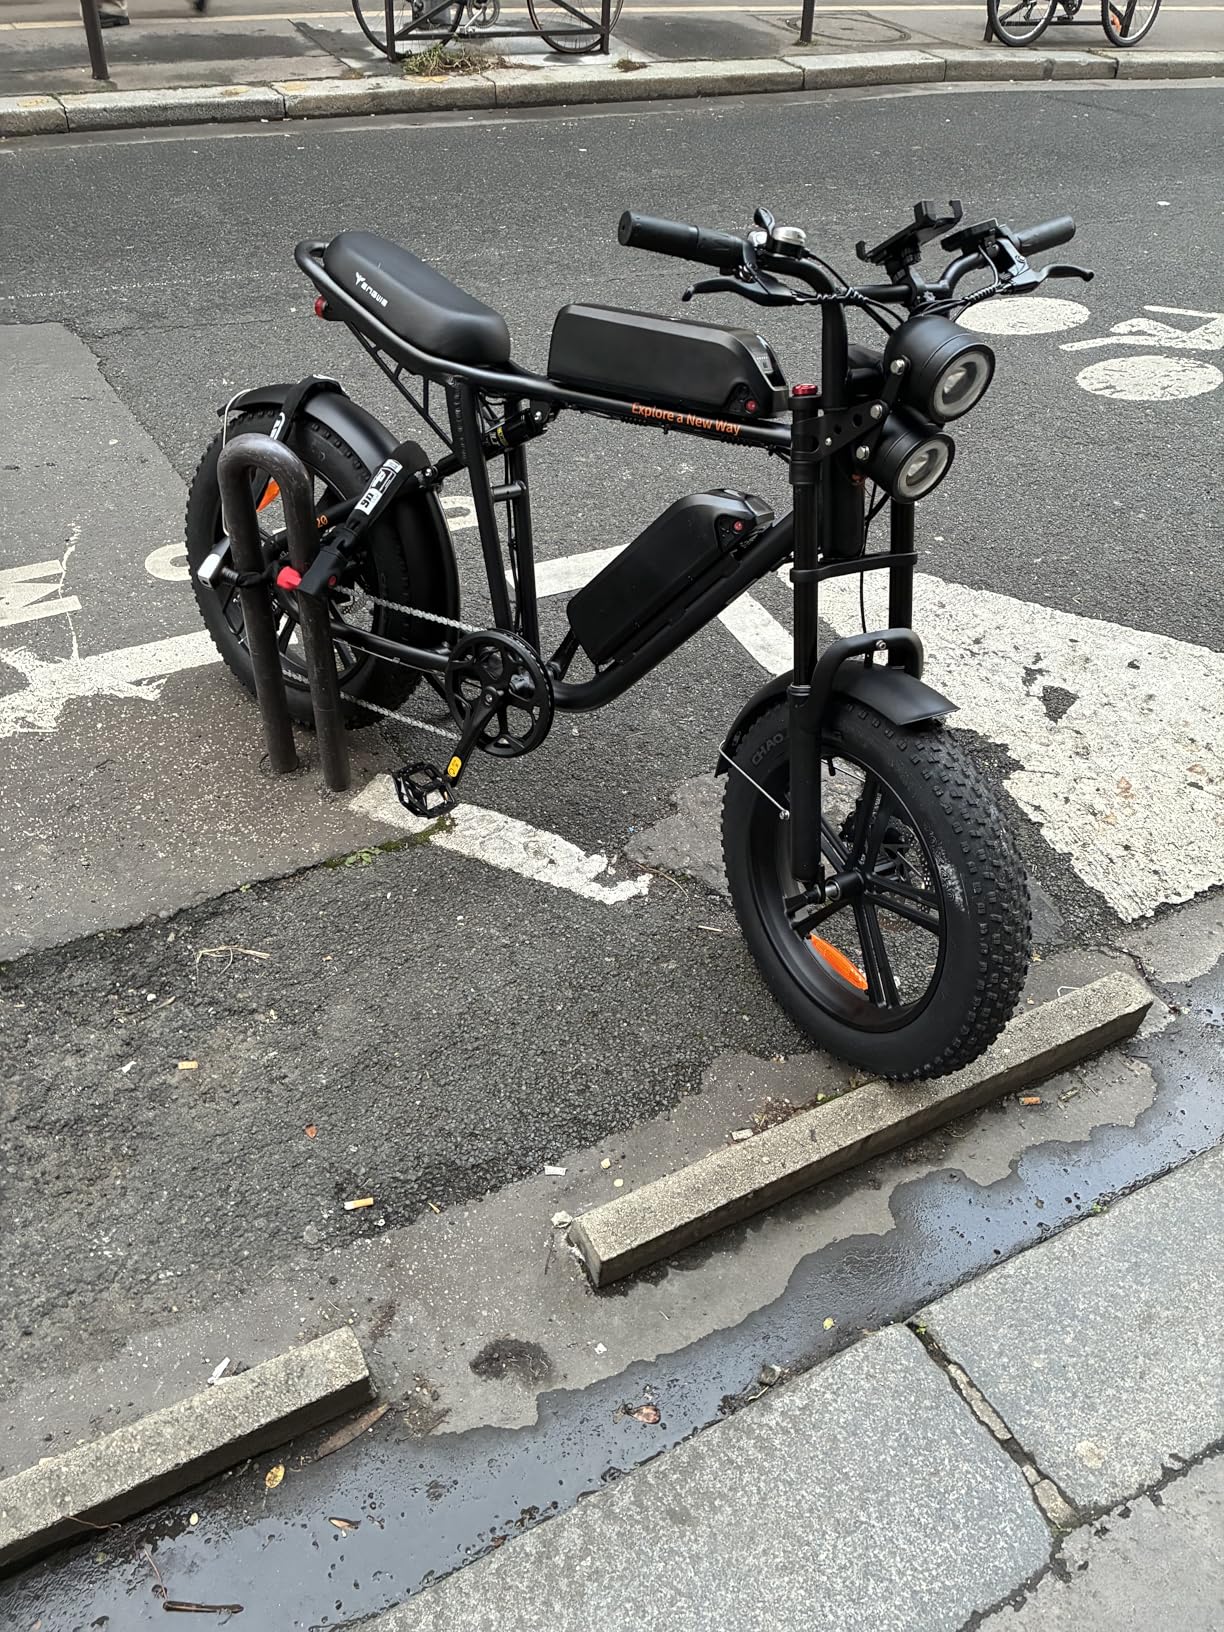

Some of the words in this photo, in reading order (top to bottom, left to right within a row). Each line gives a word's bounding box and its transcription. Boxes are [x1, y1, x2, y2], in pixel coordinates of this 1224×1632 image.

[631, 402, 674, 421] Explore
[676, 415, 684, 424] a
[686, 414, 712, 430] New
[715, 419, 741, 436] Way
[752, 733, 784, 765] CHAO
